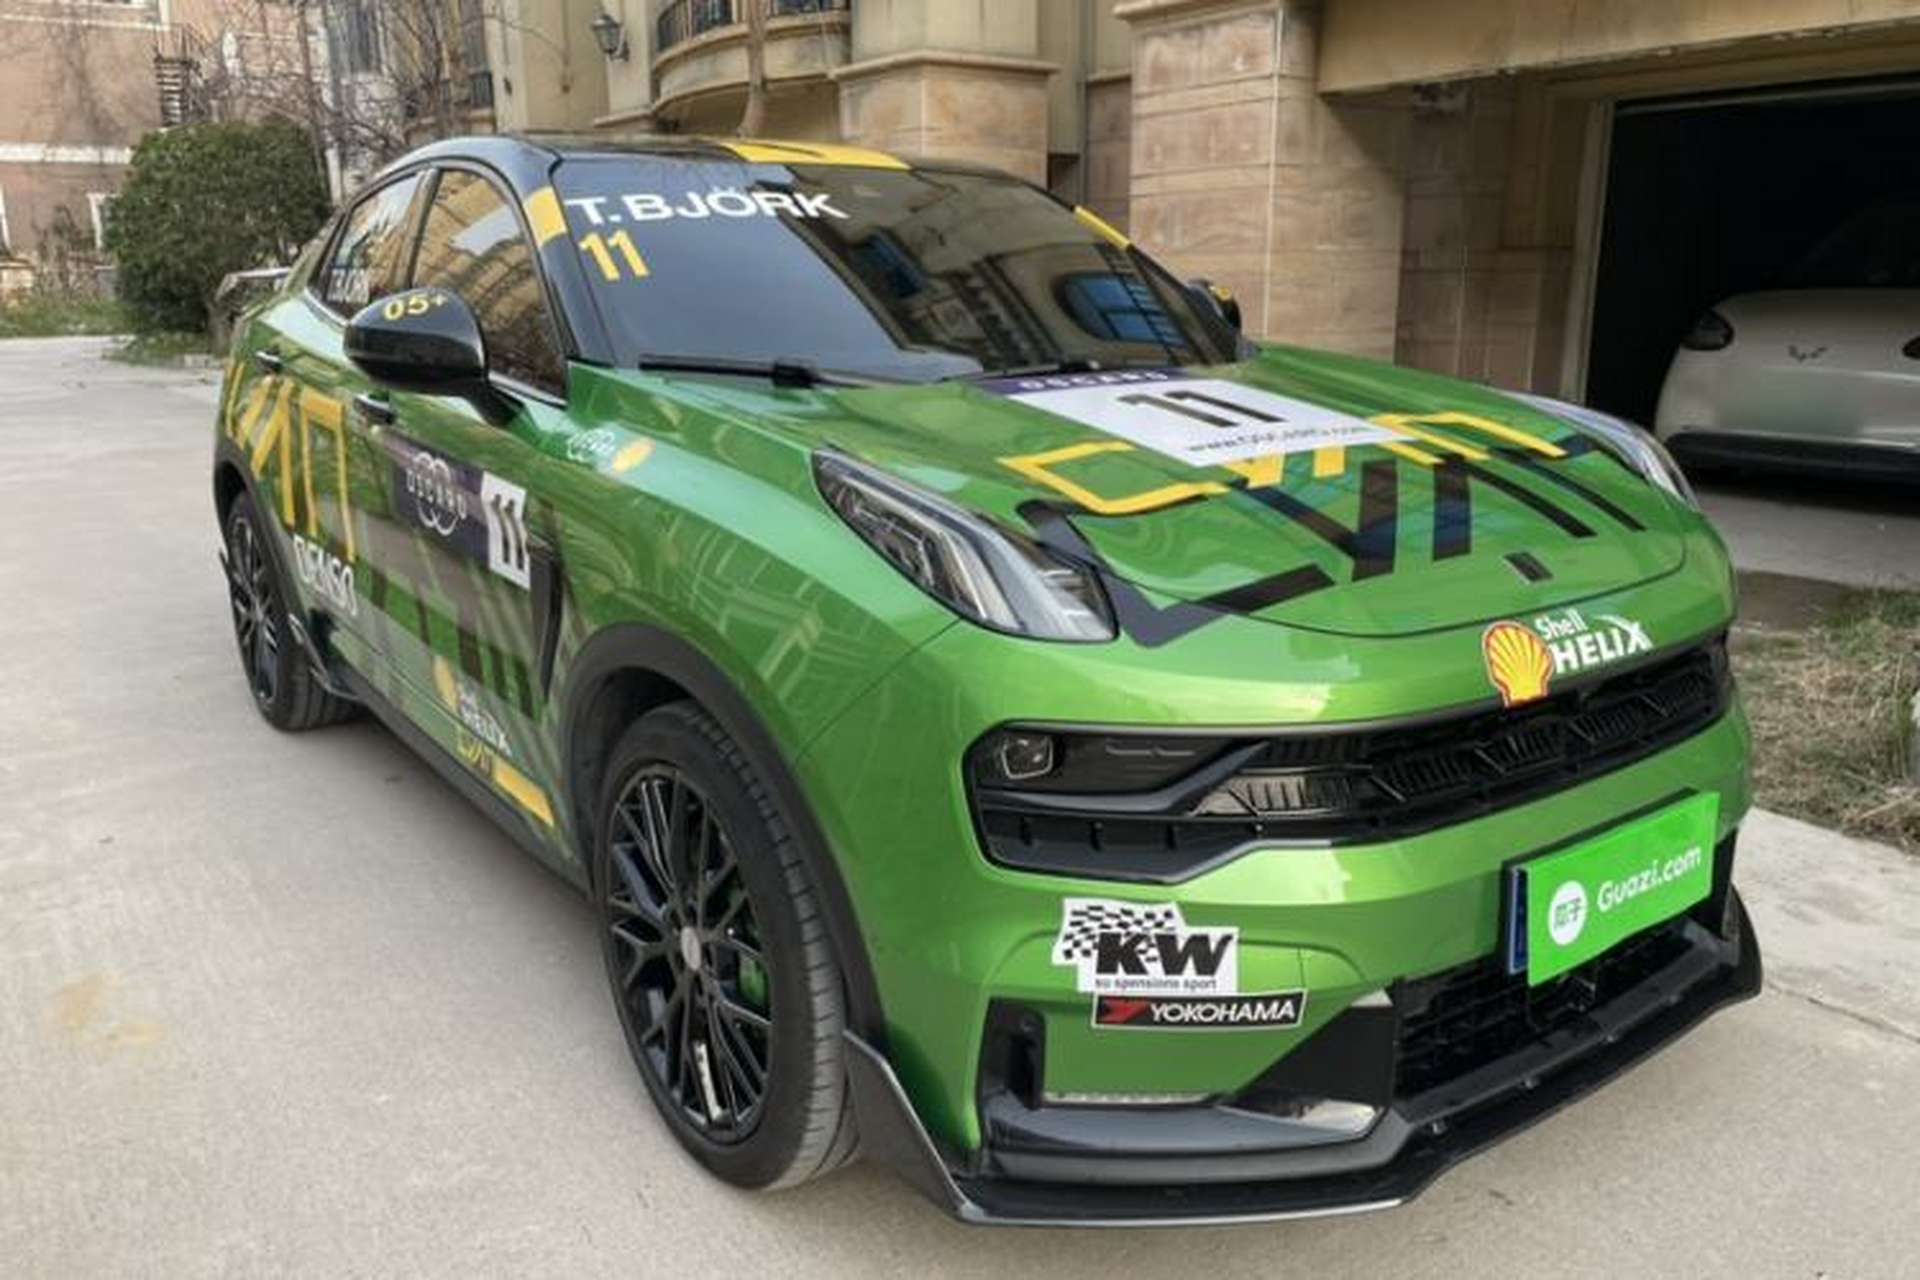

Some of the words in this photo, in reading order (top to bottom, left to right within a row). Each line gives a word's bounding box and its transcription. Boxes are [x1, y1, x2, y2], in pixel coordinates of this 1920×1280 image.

[578, 229, 651, 282] 11
[1116, 390, 1288, 428] 11
[491, 492, 525, 572] 11
[1534, 606, 1588, 640] Shell
[1547, 613, 1655, 675] HELIX
[1596, 845, 1702, 913] Guazi.com
[1183, 978, 1217, 991] sport
[1149, 999, 1296, 1023] YOKOHAMA
